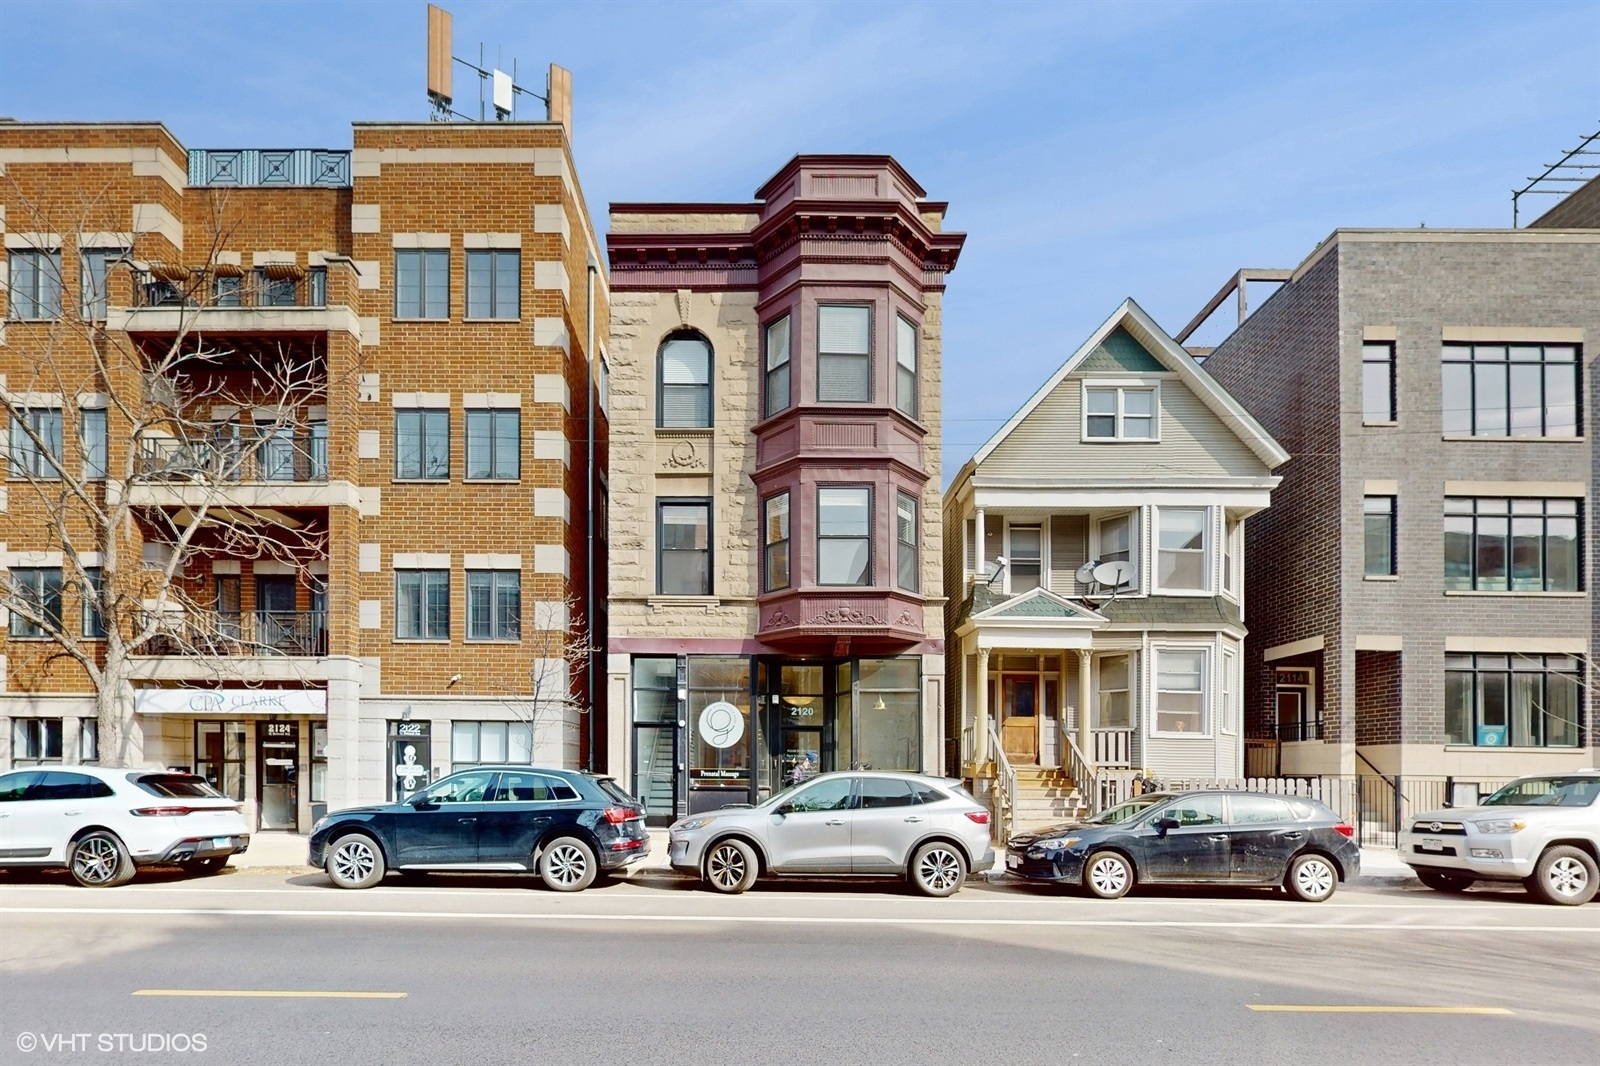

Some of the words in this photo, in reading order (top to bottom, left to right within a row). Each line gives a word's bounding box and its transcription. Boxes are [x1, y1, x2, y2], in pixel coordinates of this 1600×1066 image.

[1279, 673, 1304, 683] 2114
[190, 694, 223, 711] CPA
[231, 695, 287, 707] CLARKE
[791, 707, 814, 716] 2120
[268, 724, 291, 733] 2124
[399, 723, 421, 731] 2122
[720, 770, 740, 779] Massage
